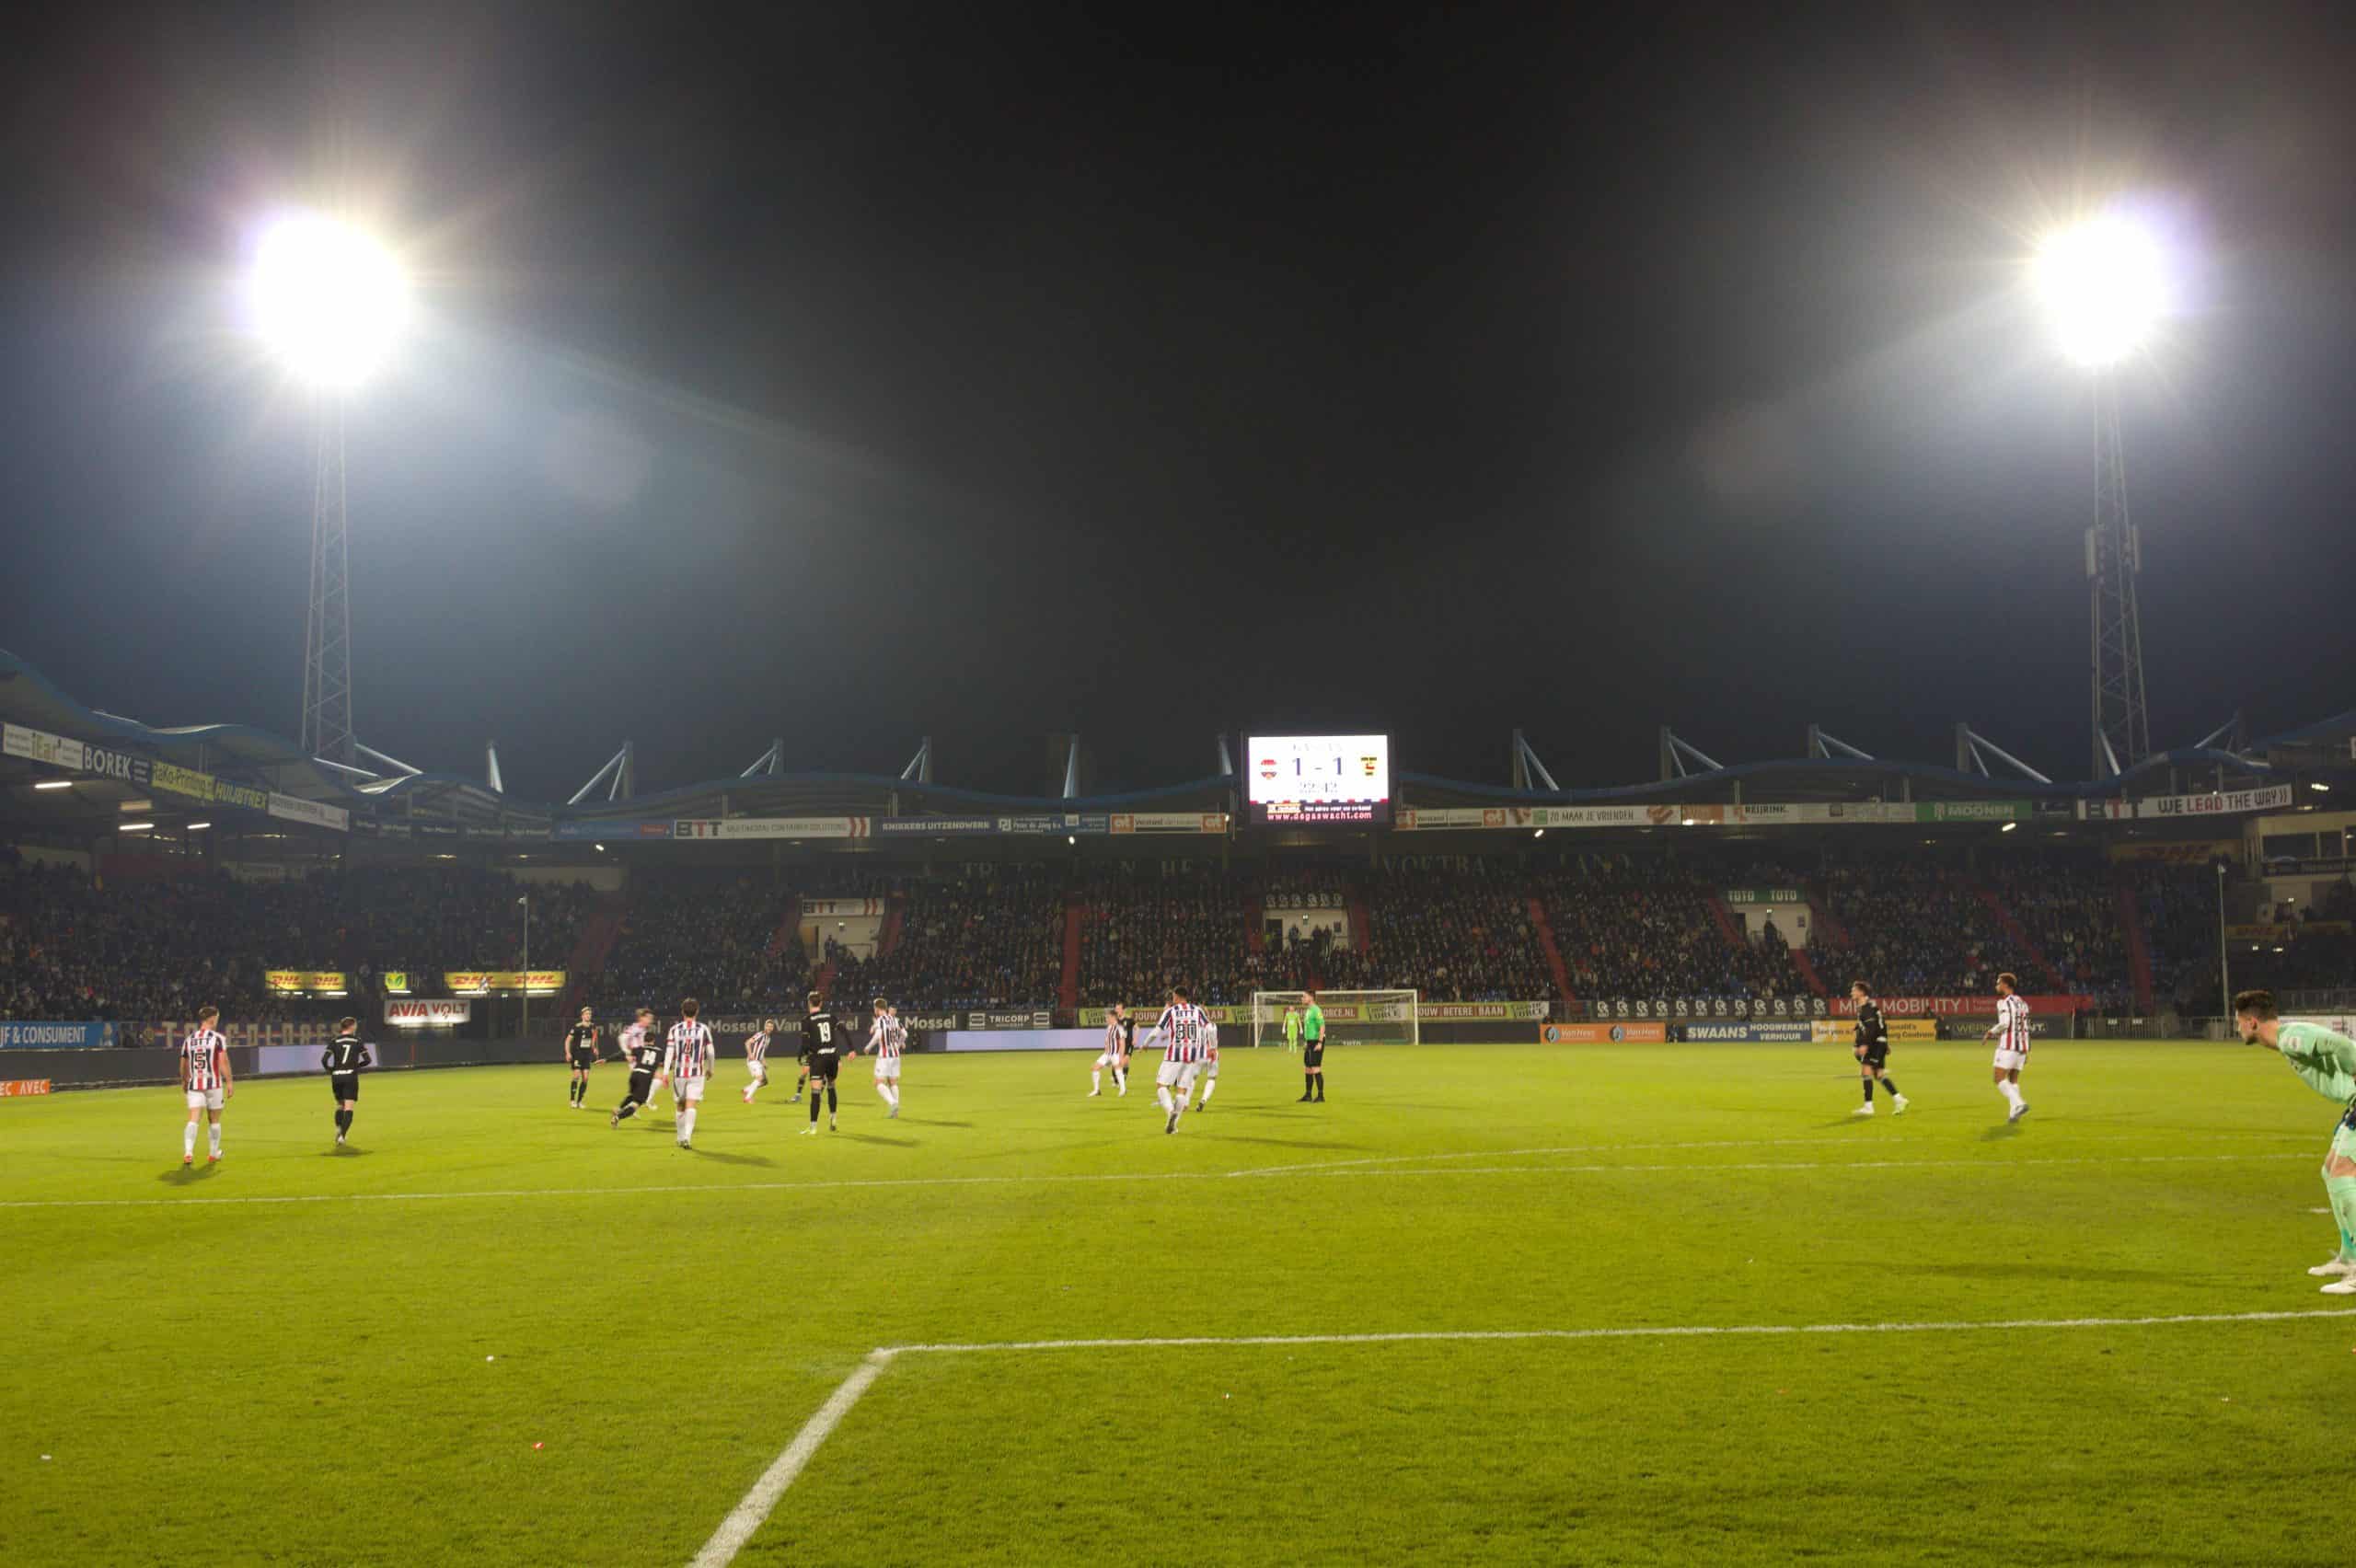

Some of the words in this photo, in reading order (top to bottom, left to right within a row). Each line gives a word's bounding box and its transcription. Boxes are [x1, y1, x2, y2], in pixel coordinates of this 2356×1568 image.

[85, 745, 132, 779] BOREK
[1292, 757, 1301, 776] 1
[1333, 756, 1343, 776] 1
[2158, 799, 2182, 813] WE
[2187, 795, 2223, 812] LEAD
[2226, 793, 2251, 810] THE
[2255, 787, 2277, 805] WAY
[1267, 812, 1371, 821] www.degaswacht.com
[1562, 811, 1584, 821] MAAK
[1586, 810, 1595, 820] JE
[1597, 810, 1634, 820] VRIENDEN
[676, 821, 722, 836] BTT
[1728, 890, 1754, 902] TOTO
[1770, 890, 1796, 901] TOTO
[272, 975, 301, 986] DHL
[313, 976, 340, 986] DHL
[455, 975, 494, 985] DHL
[514, 975, 554, 984] DHL
[432, 1003, 468, 1017] VOLT
[1882, 998, 1959, 1014] MOBILITY
[709, 1014, 759, 1032] Mossel
[773, 1016, 802, 1031] Van
[905, 1015, 956, 1030] Mossel
[988, 1015, 1030, 1023] TRICORP
[13, 1027, 20, 1043] &
[22, 1025, 87, 1043] CONSUMENT
[817, 1021, 832, 1043] 19
[1688, 1027, 1748, 1039] SWAANS
[1759, 1032, 1801, 1041] VERHUUR
[194, 1051, 206, 1070] 5
[342, 1044, 352, 1065] 7
[20, 1079, 46, 1095] AVEC
